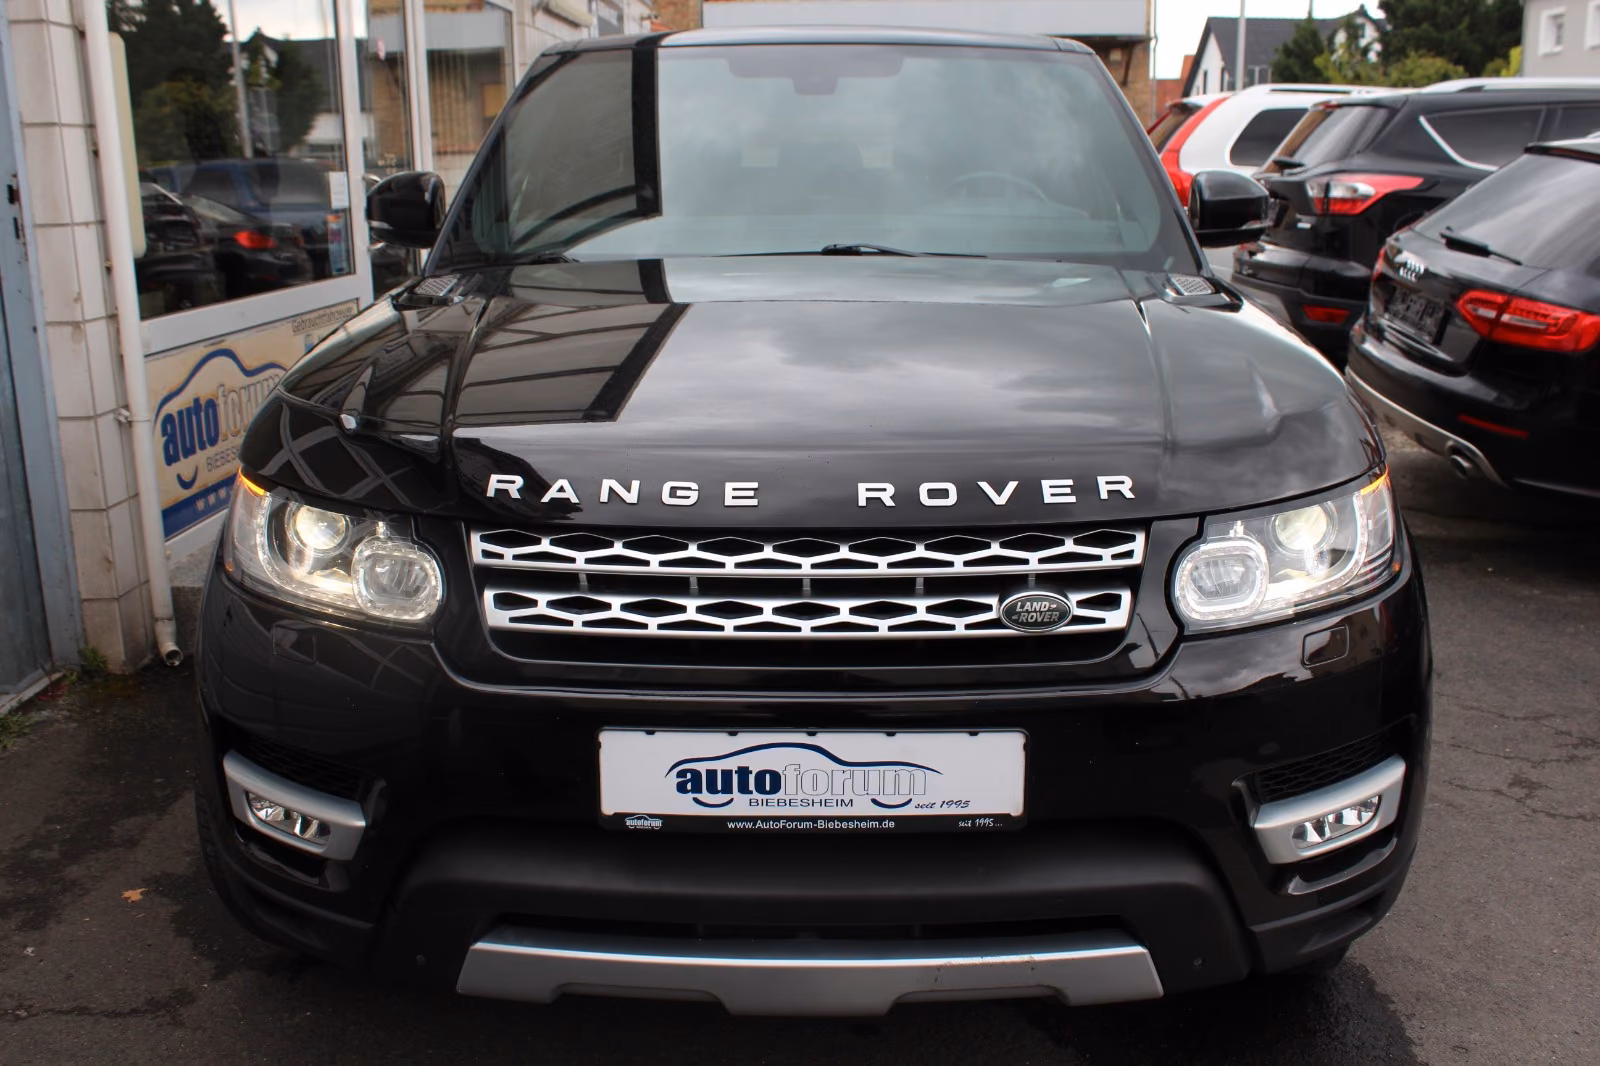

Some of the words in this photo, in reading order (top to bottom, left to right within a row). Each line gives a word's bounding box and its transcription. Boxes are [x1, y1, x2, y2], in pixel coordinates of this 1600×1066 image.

[485, 473, 760, 507] RANGE
[857, 474, 1136, 508] ROVER
[675, 763, 927, 797] autoforum
[748, 798, 854, 808] BIEBESHEIM
[914, 801, 937, 809] seit
[939, 799, 971, 809] 1995
[727, 819, 896, 830] www.AutoForum-Biebesheim.de
[958, 820, 972, 828] seit
